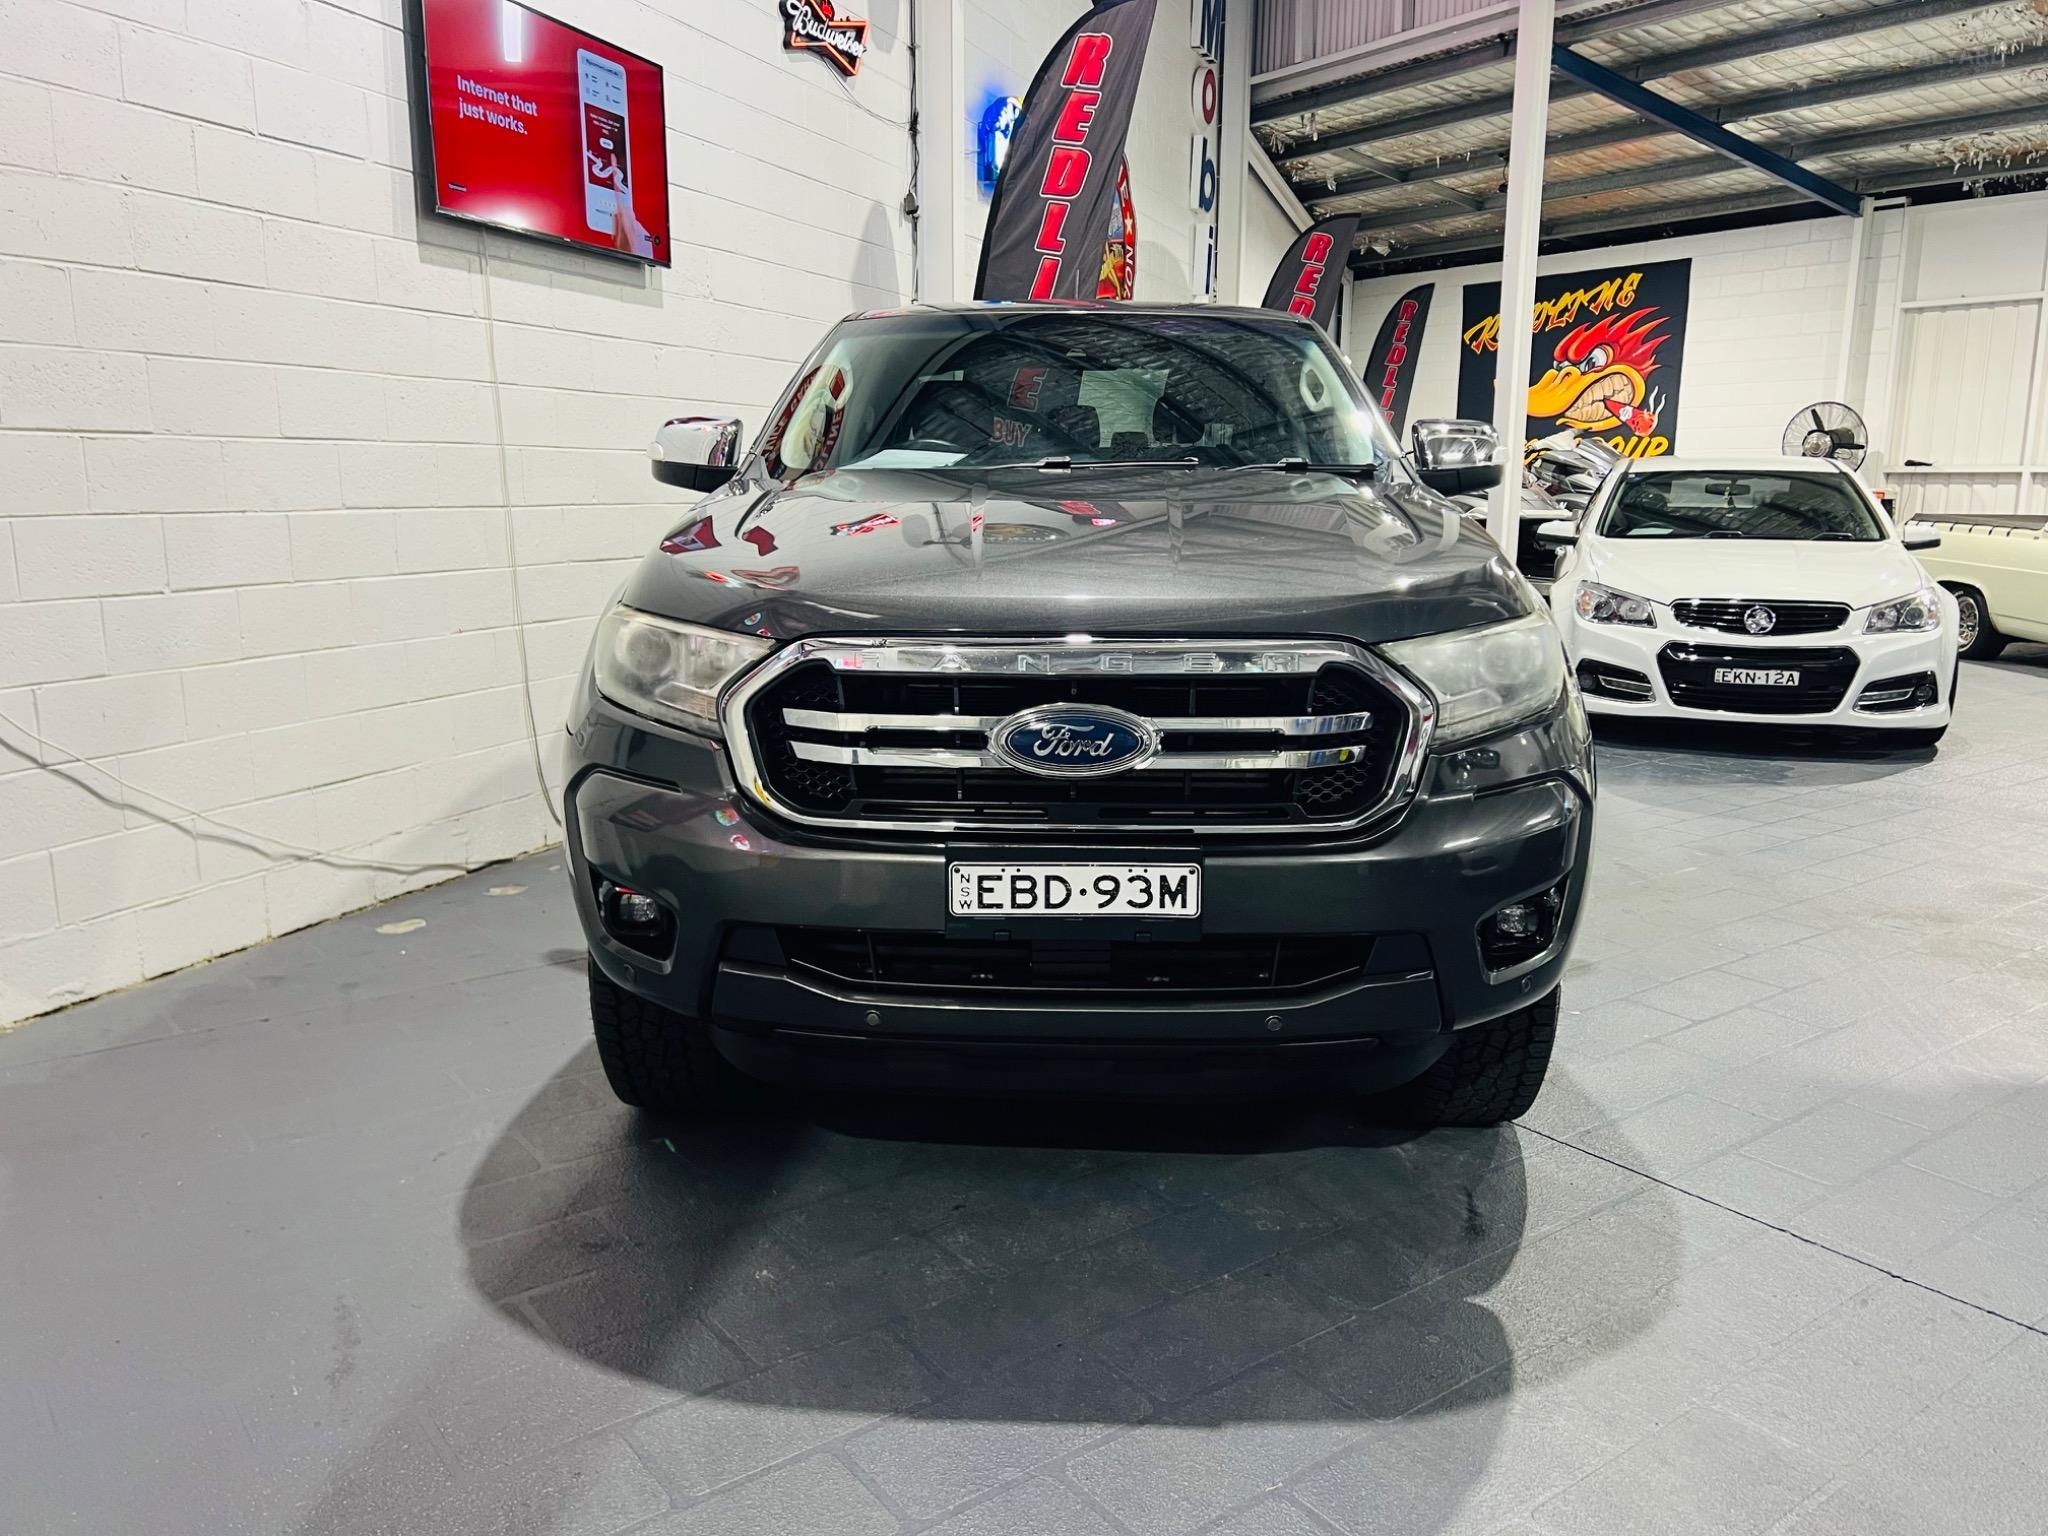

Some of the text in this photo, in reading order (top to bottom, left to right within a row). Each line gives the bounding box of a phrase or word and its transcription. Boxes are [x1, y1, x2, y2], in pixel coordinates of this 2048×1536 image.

[786, 0, 865, 57] Budweiser
[457, 74, 538, 117] Internet that
[459, 97, 528, 135] just works.
[990, 416, 1032, 448] BUY
[1032, 724, 1114, 757] Ford
[959, 873, 973, 910] NSW
